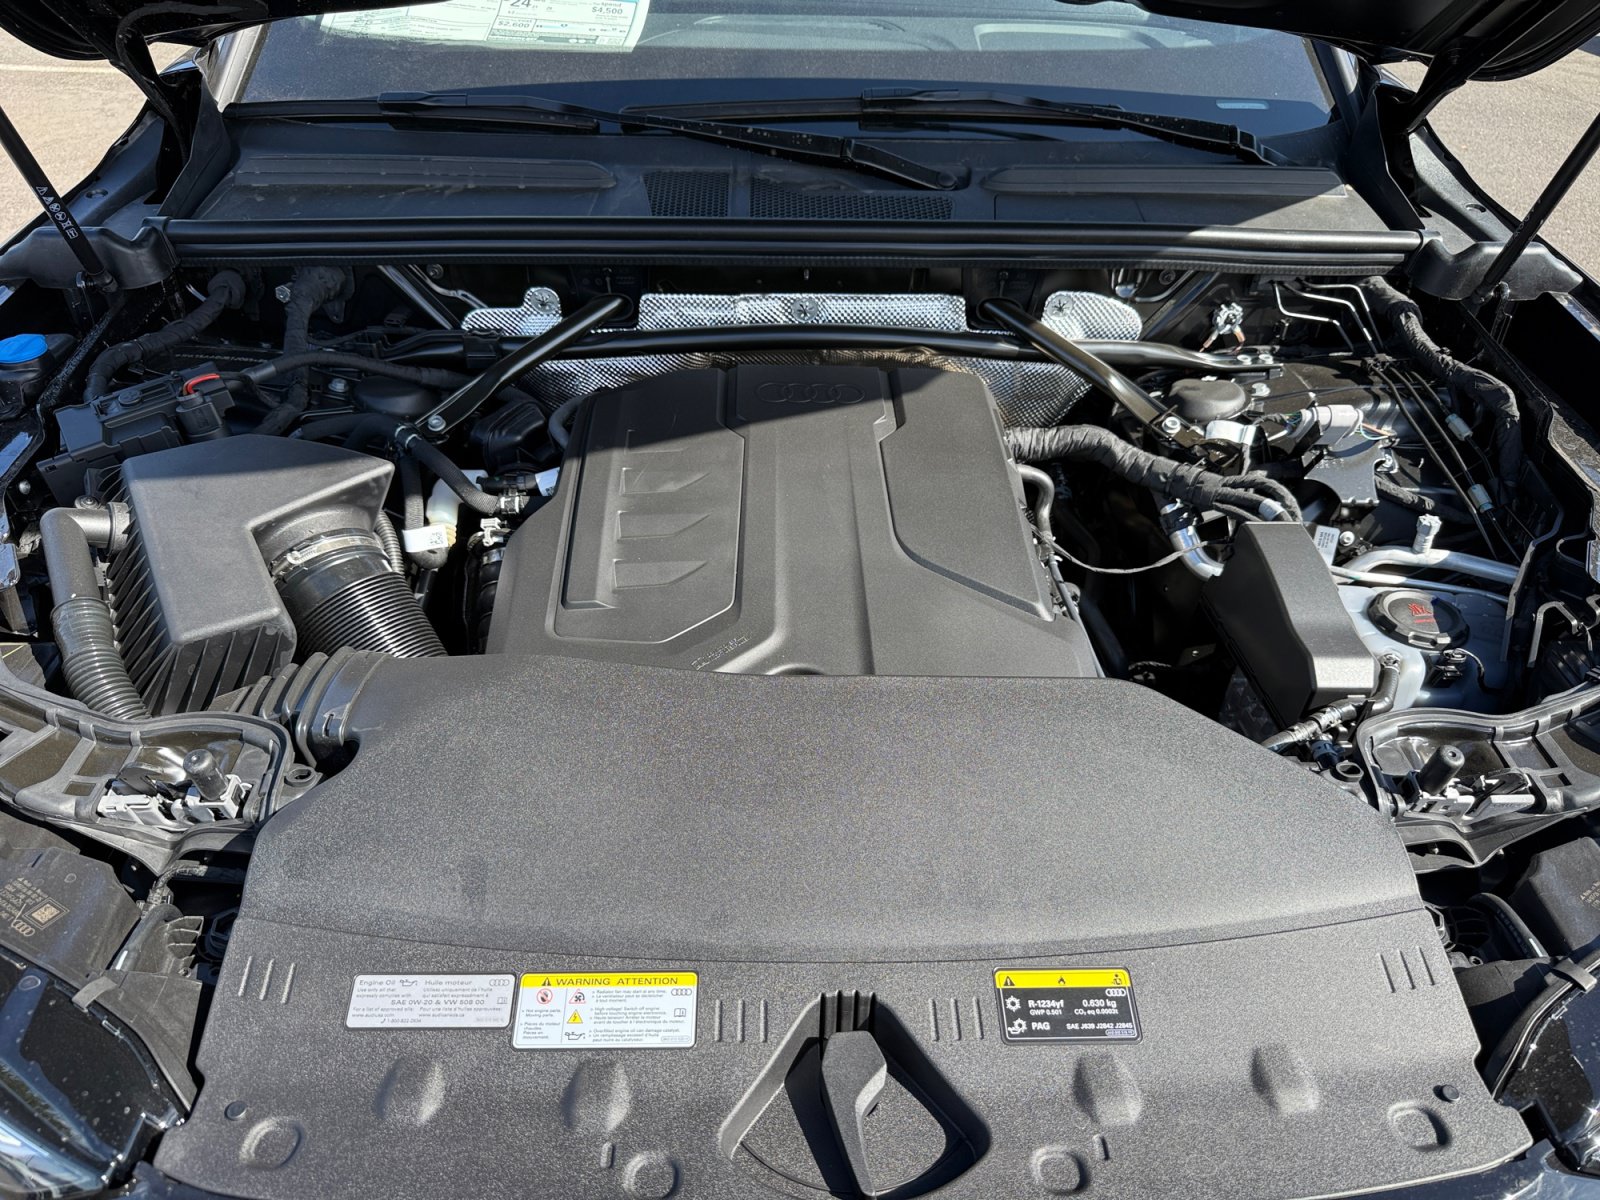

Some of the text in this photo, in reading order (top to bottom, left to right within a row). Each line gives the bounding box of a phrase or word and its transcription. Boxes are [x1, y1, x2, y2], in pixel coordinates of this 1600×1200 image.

[592, 6, 623, 15] $4,500
[498, 20, 530, 29] $2,600
[556, 976, 679, 986] WARNING ATTENTION
[1028, 999, 1064, 1009] R-1234yf
[1082, 999, 1117, 1008] 0.630 kg
[1031, 1022, 1051, 1030] PAG
